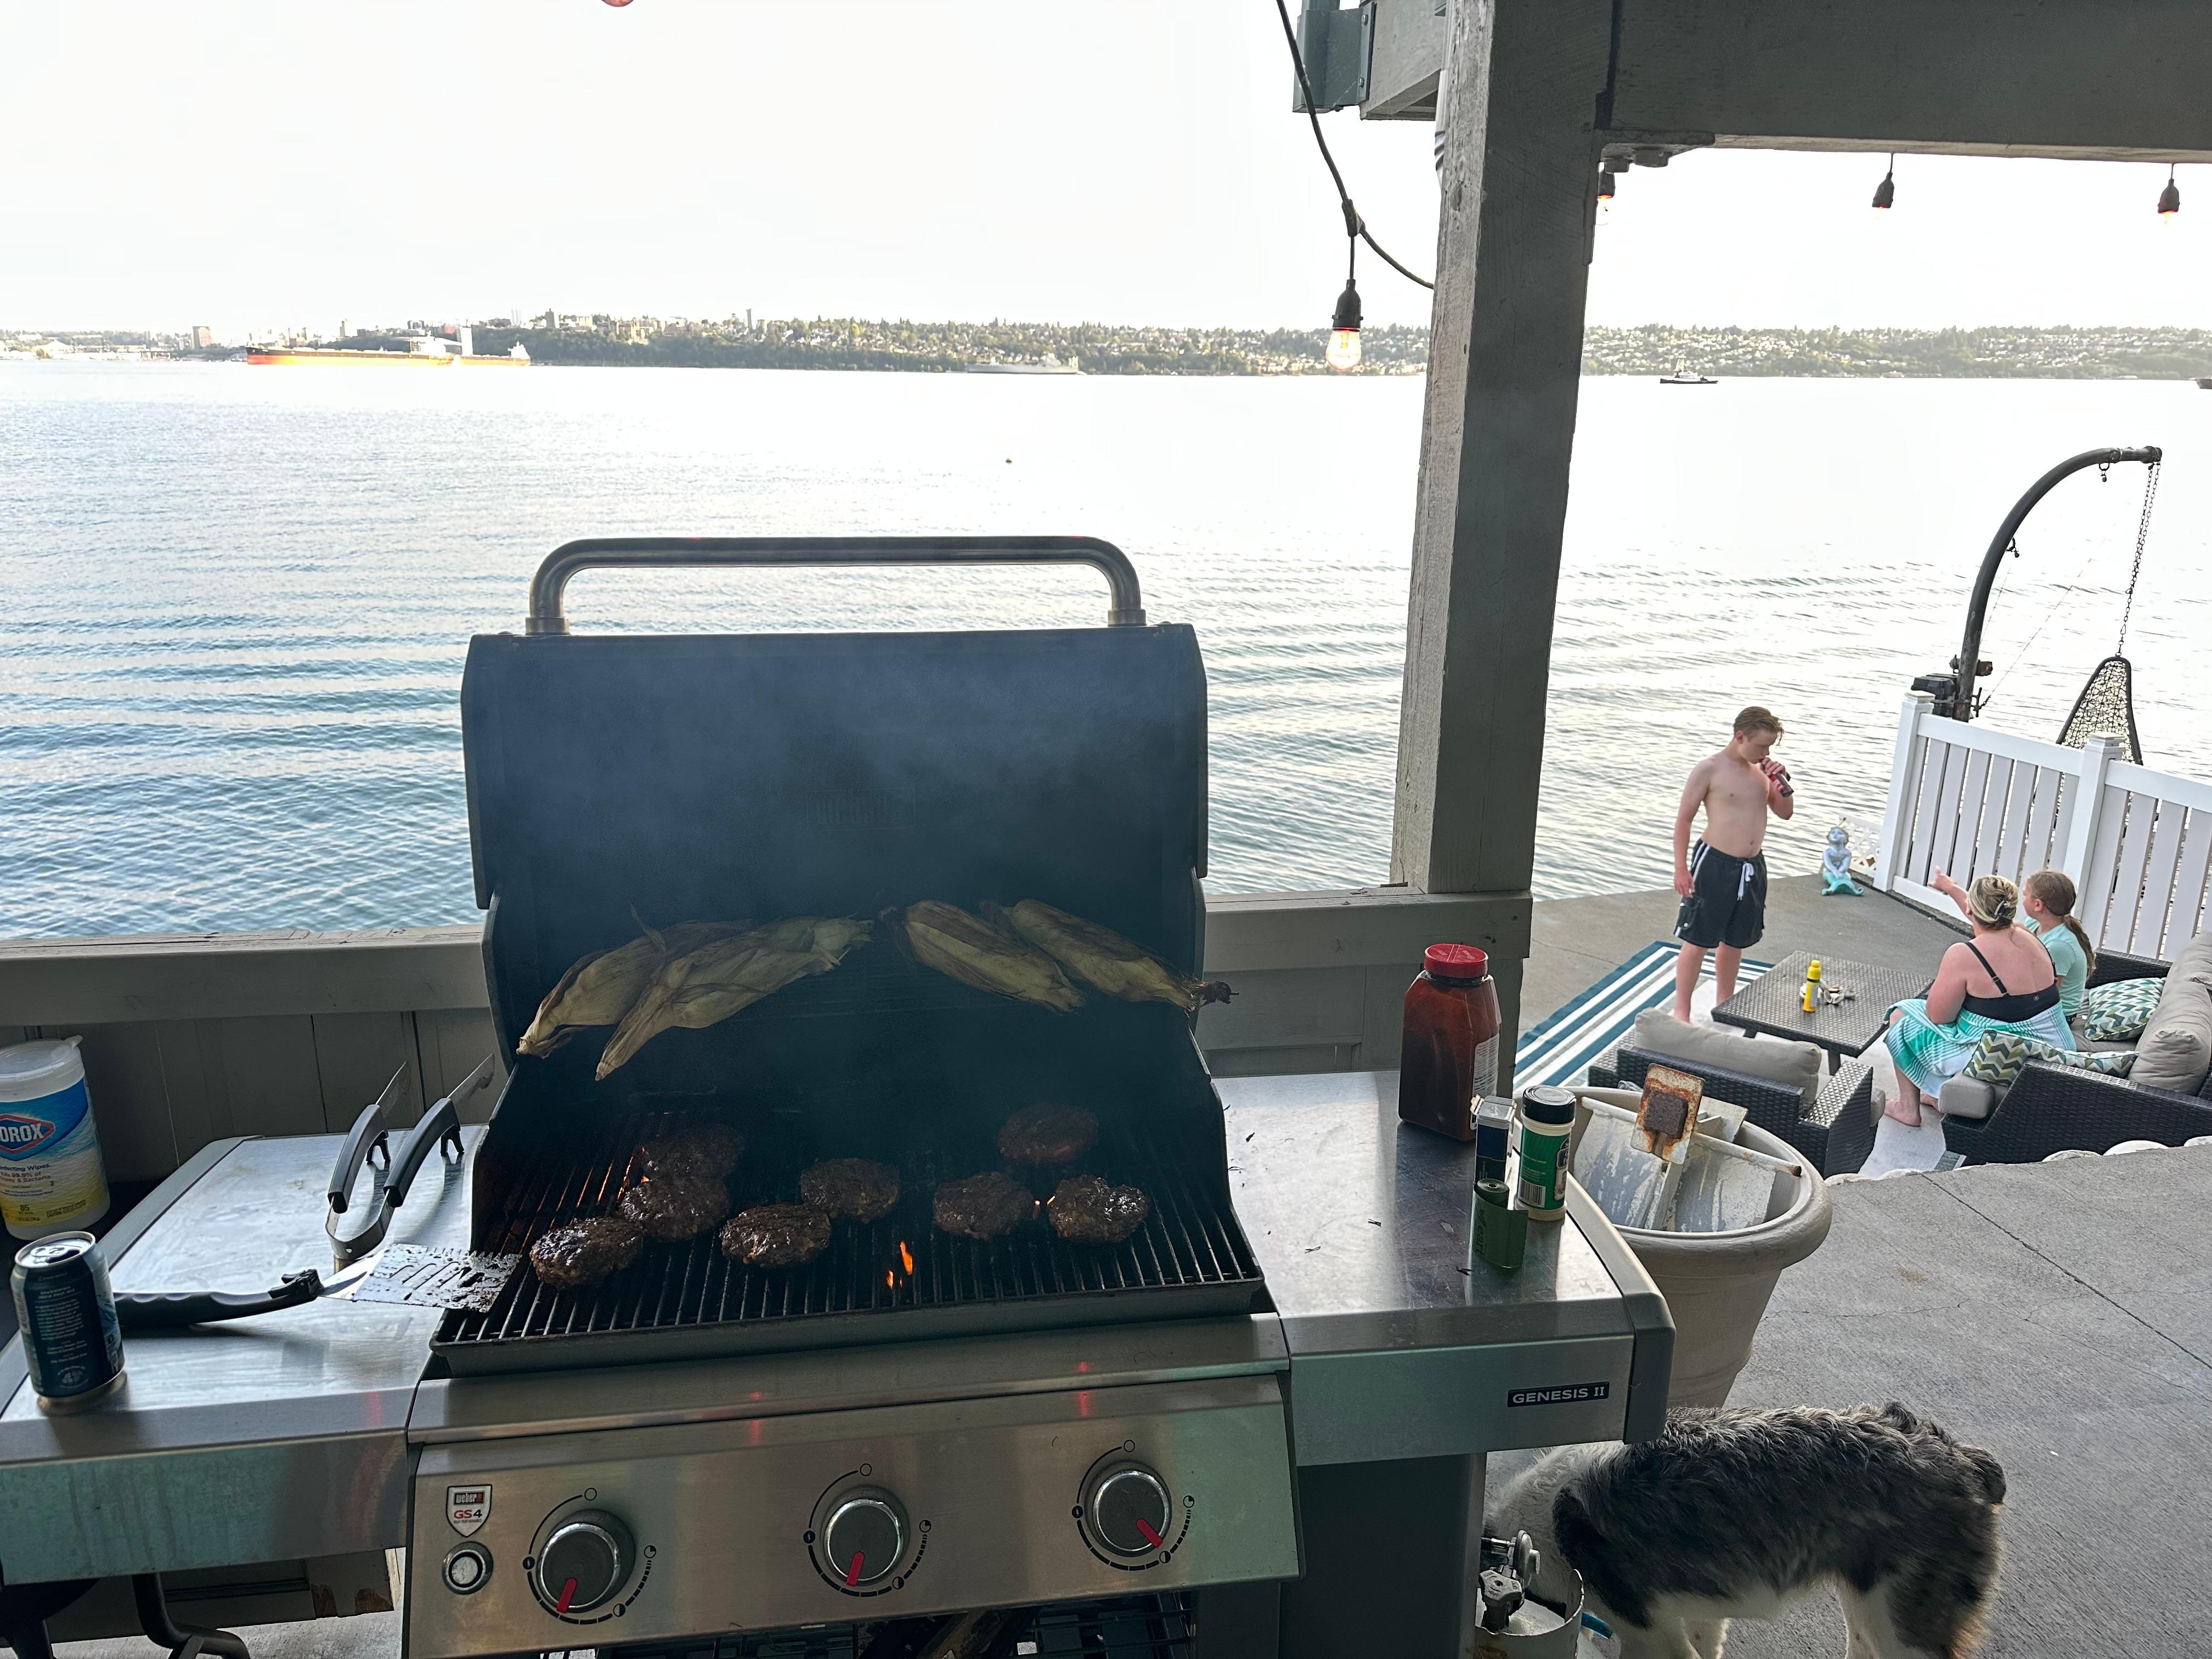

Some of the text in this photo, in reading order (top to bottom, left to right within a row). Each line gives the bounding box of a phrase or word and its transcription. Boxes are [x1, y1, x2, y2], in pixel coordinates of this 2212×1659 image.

[1513, 1386, 1605, 1403] GENESIS II
[456, 1492, 477, 1503] weber
[454, 1509, 483, 1519] GS4
